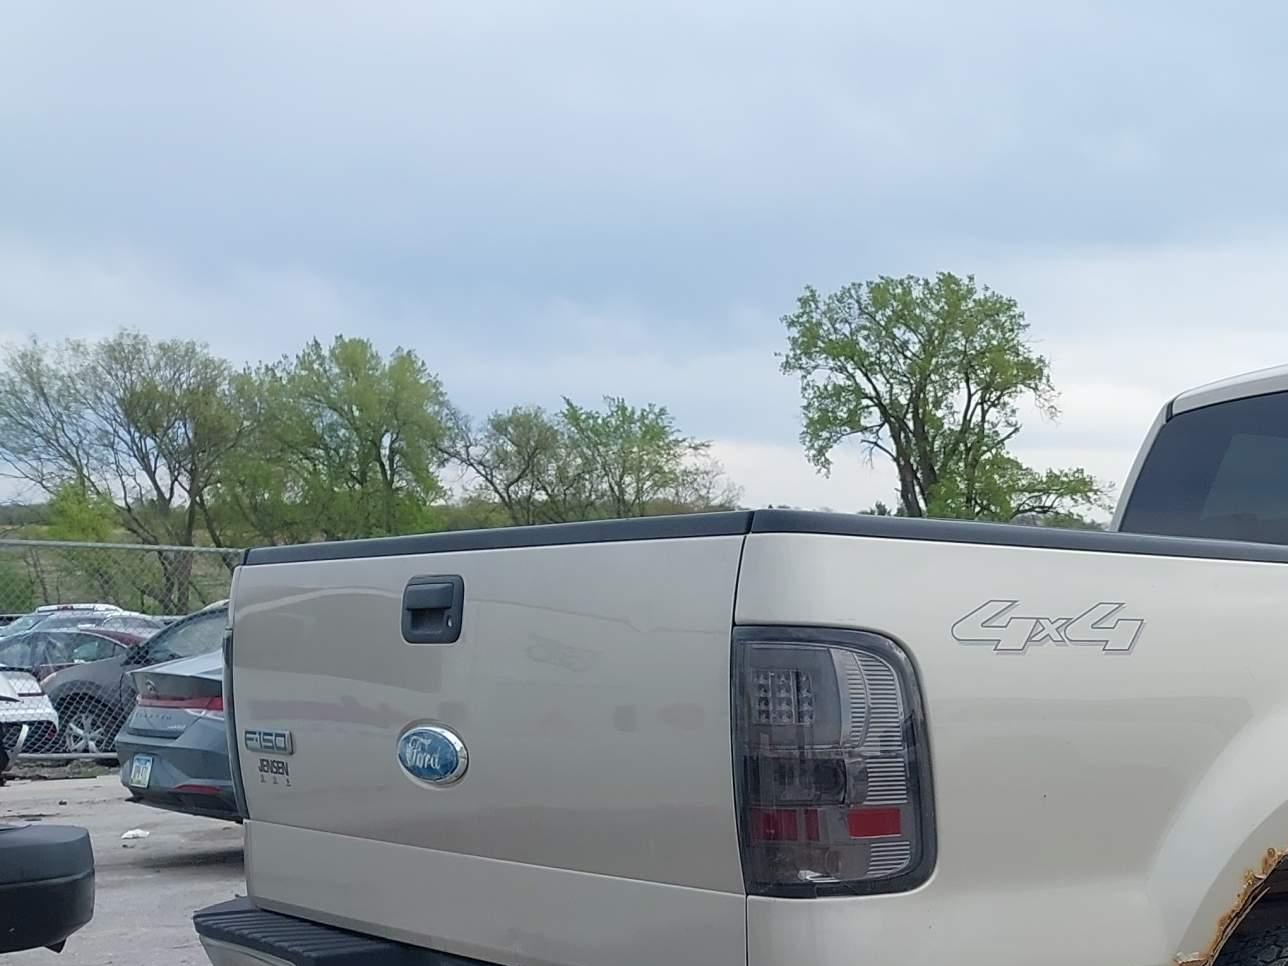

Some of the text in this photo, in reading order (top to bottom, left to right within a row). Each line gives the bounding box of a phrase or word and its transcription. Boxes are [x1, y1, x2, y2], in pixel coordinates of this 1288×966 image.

[951, 600, 1146, 655] 4x4
[258, 758, 290, 777] JENSEN
[406, 736, 441, 770] Ford
